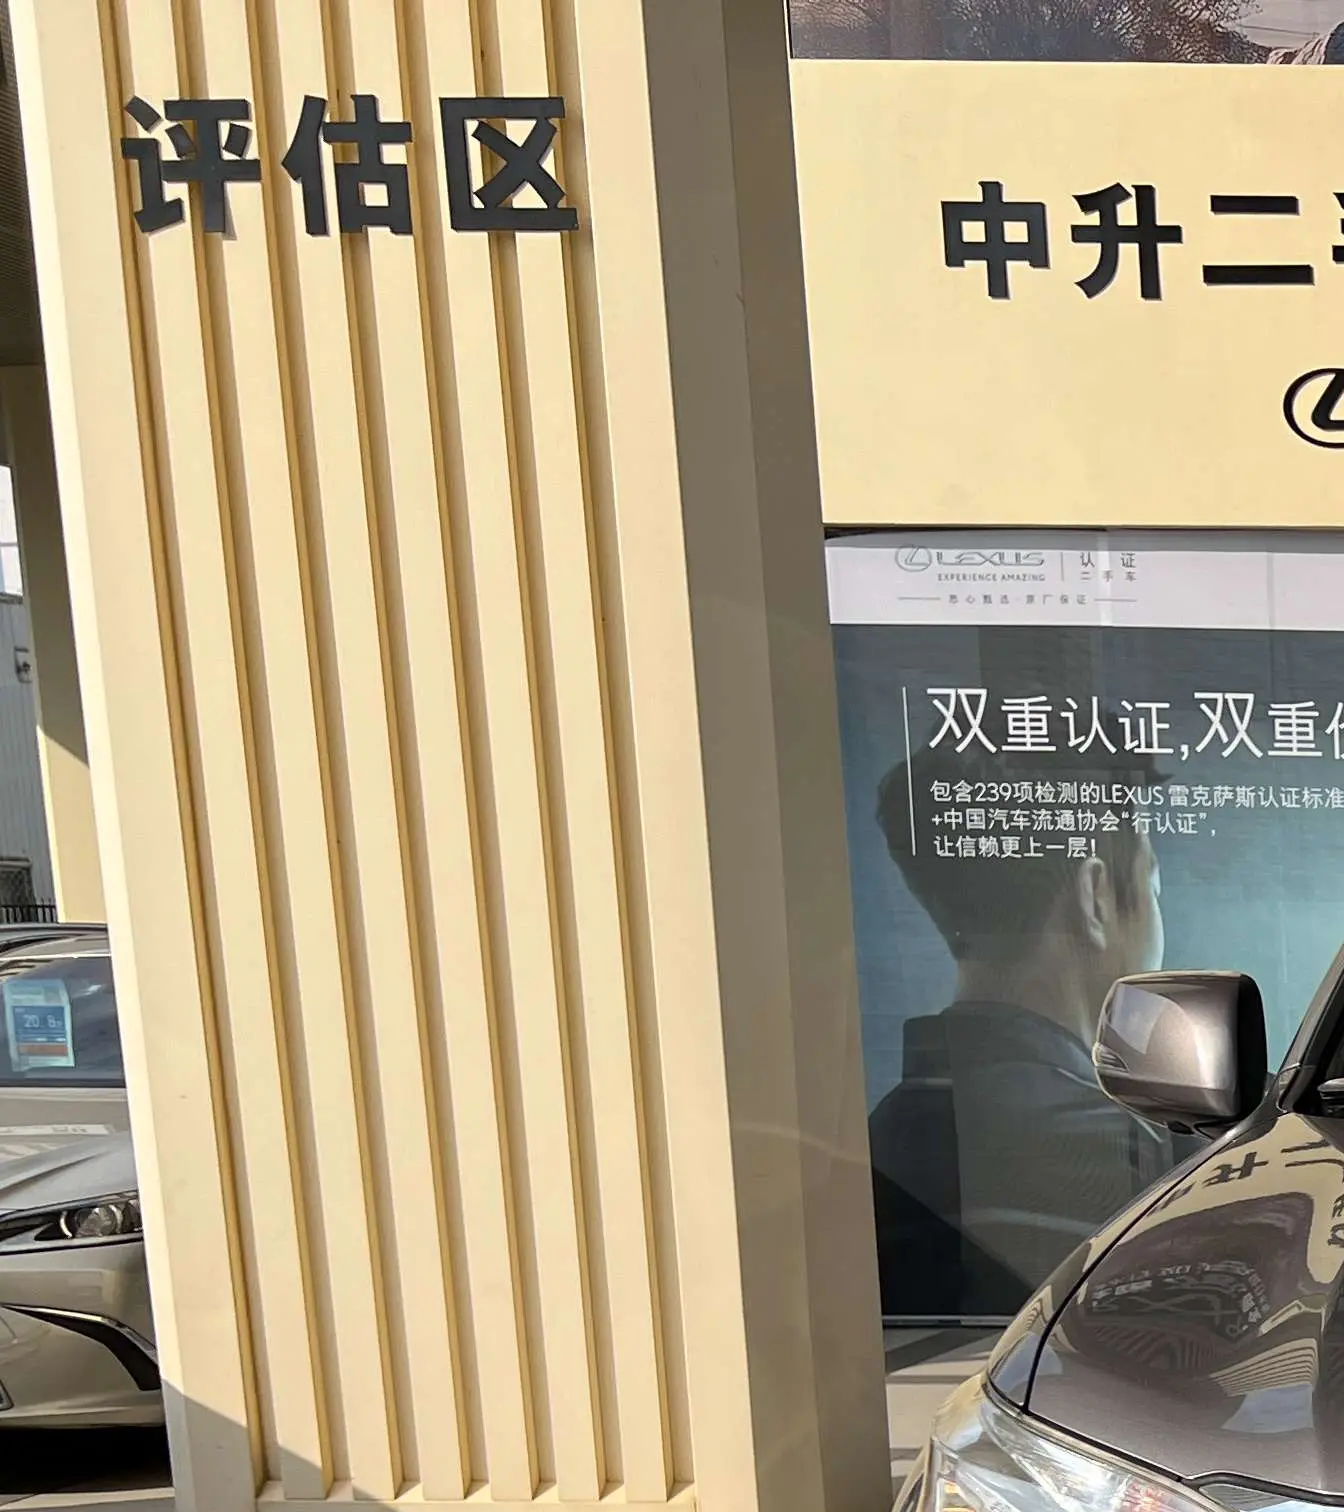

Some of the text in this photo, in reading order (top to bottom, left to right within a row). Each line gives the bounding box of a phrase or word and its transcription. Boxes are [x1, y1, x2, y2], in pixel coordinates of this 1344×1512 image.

[121, 94, 579, 237] 评估区
[936, 551, 1045, 566] LEXUS
[1079, 552, 1137, 569] 认证
[937, 573, 1046, 582] EXPERIENCE AMAZING
[1079, 571, 1137, 582] 二手车
[930, 780, 1164, 807] 包含239项检测的LEXUS
[933, 835, 1097, 859] 让信赖更上一层！
